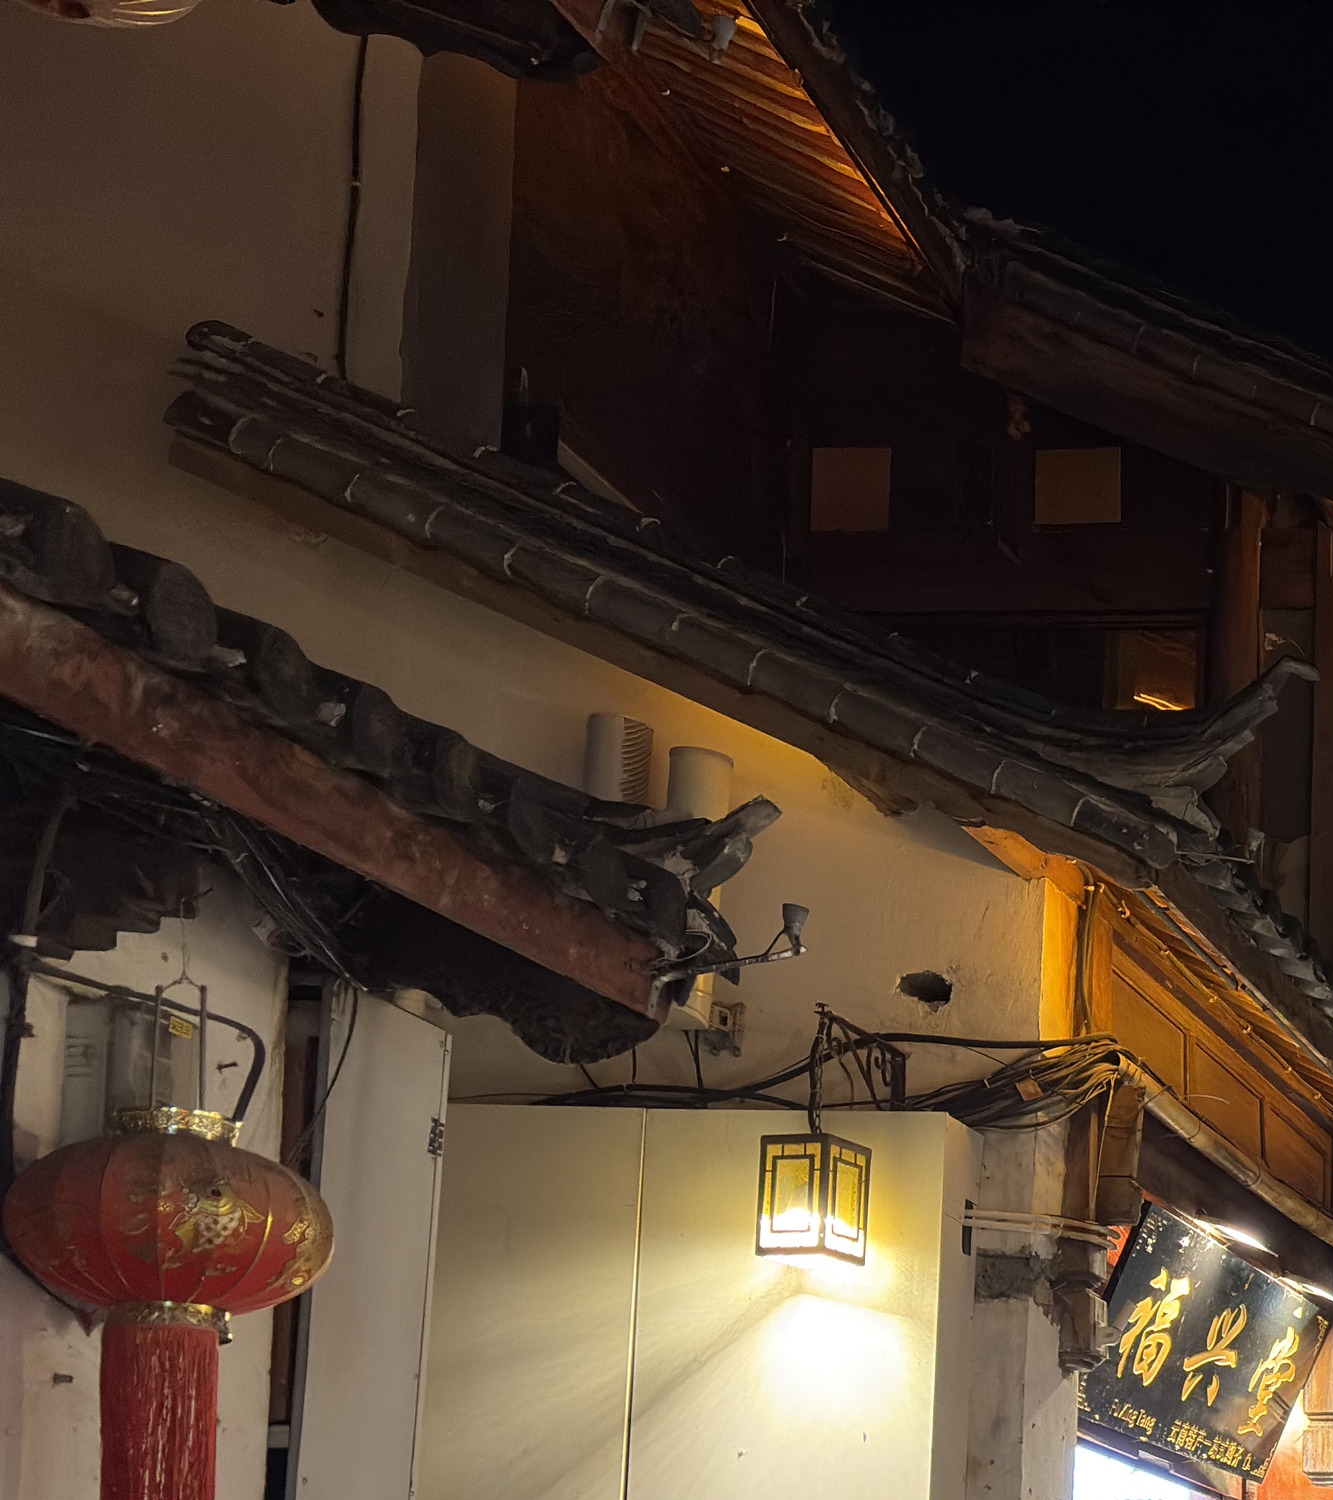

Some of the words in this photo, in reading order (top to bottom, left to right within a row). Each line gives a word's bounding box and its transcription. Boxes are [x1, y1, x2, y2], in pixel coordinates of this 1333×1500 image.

[1117, 1266, 1300, 1437] 福兴堂
[1136, 1408, 1157, 1435] Tang
